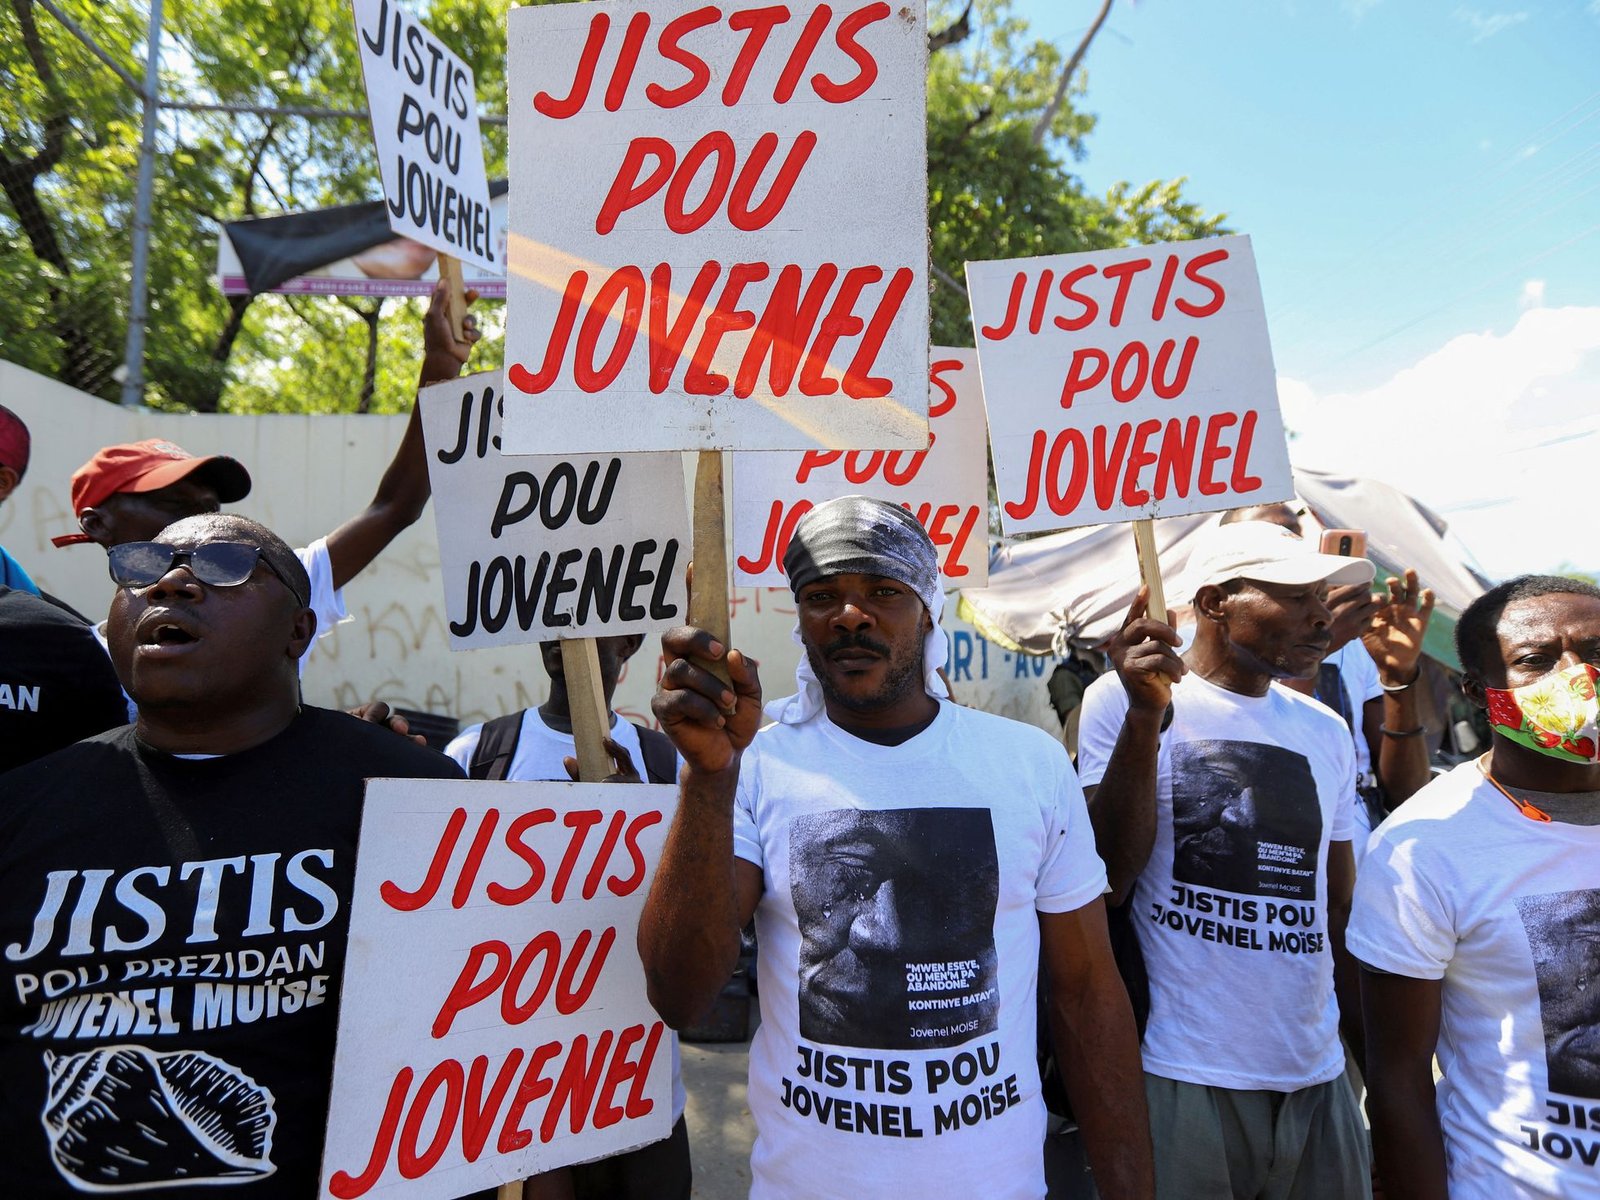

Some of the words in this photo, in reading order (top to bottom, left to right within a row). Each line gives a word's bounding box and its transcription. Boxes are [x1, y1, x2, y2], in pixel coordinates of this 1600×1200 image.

[362, 0, 468, 120] JISTIS
[533, 1, 891, 119] JISTIS
[397, 92, 462, 176] POU
[388, 154, 495, 263] JOVENEL
[596, 130, 817, 235] POU
[508, 260, 914, 400] JOVENEL
[981, 249, 1229, 341] JISTIS
[1060, 336, 1199, 409] POU
[490, 457, 622, 539] POU
[1004, 410, 1262, 520] JOVENEL
[449, 538, 679, 637] JOVENEL
[380, 807, 663, 911] JISTIS
[5, 848, 339, 962] JISTIS
[1170, 885, 1259, 924] JISTIS
[1265, 902, 1315, 928] POU
[1268, 930, 1324, 954] MOÏSE
[15, 963, 109, 1005] POU
[121, 940, 326, 983] PREZIDAN
[431, 926, 617, 1039] POU
[906, 962, 945, 973] “MWEN
[947, 959, 980, 971] ESEYE,
[906, 972, 923, 982] OU
[961, 969, 976, 979] PA
[907, 979, 970, 991] ABANDONE.
[908, 997, 961, 1010] KONTINYE
[797, 1045, 913, 1095] JISTIS
[925, 1041, 1000, 1094] POU
[910, 1027, 949, 1038] Jovenel
[950, 1019, 979, 1035] MOISE
[328, 1020, 664, 1200] JOVENEL
[781, 1077, 923, 1138] JOVENEL
[933, 1073, 1021, 1136] MOÏSE
